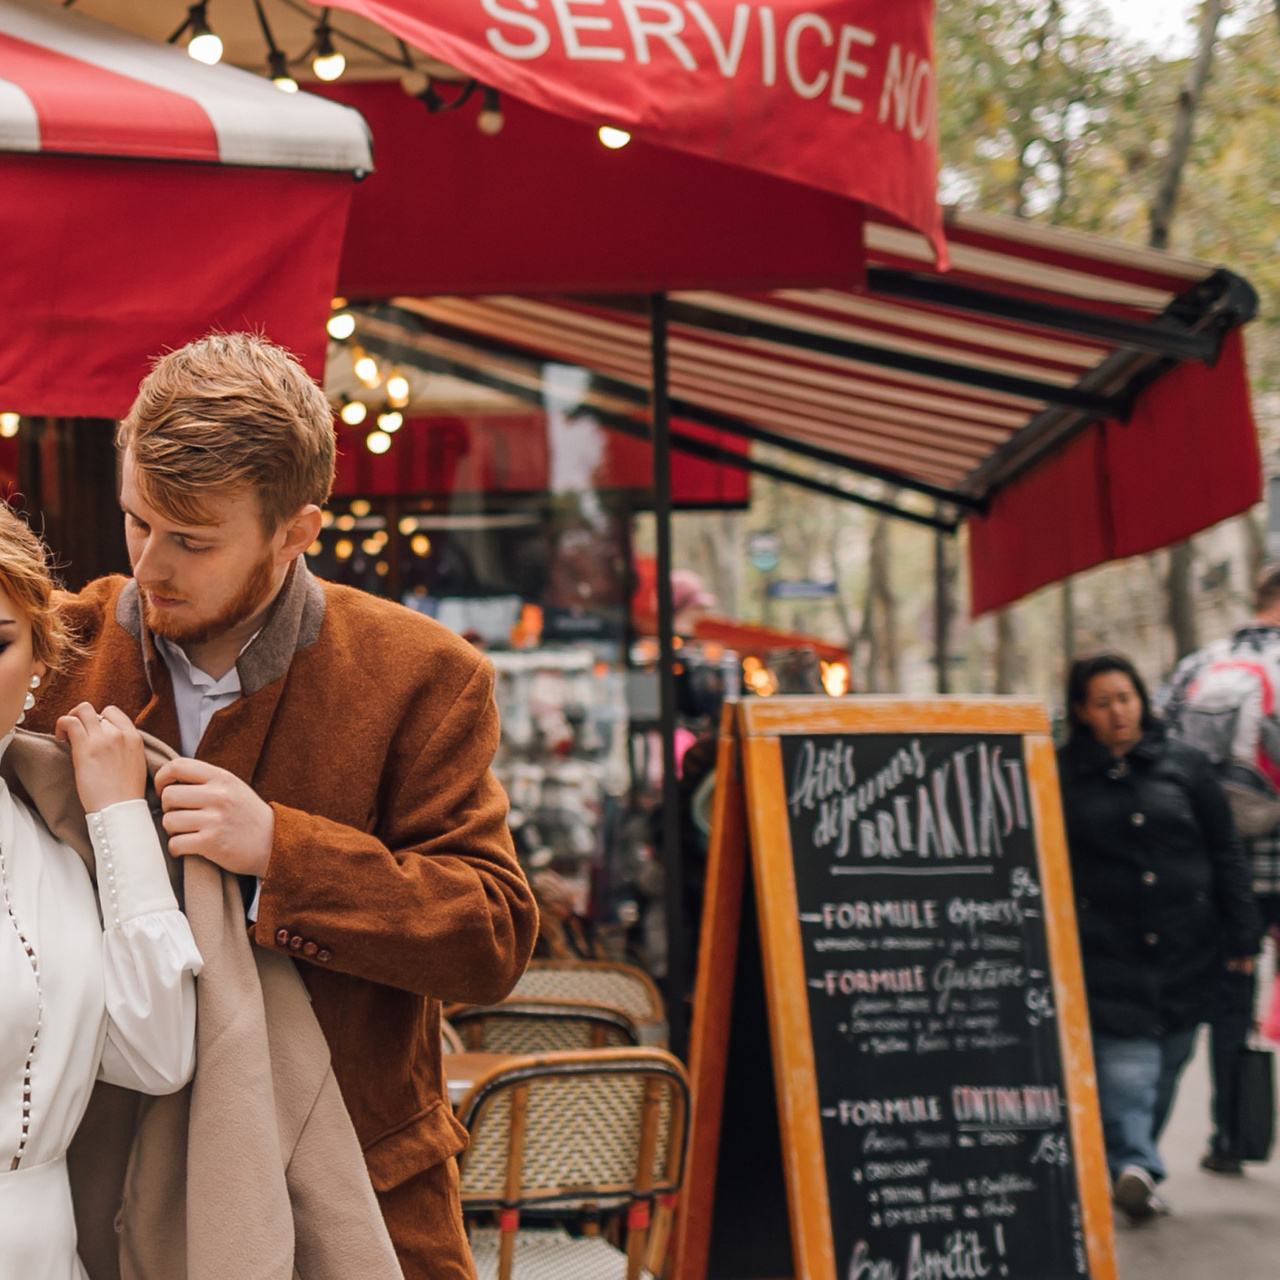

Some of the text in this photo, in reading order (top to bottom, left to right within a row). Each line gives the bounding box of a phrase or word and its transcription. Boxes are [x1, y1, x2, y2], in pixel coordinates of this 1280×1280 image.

[859, 741, 1028, 859] BREAKFAST
[822, 899, 938, 930] FORMULE
[824, 965, 926, 996] FORMULE
[838, 1096, 943, 1126] FORMULE
